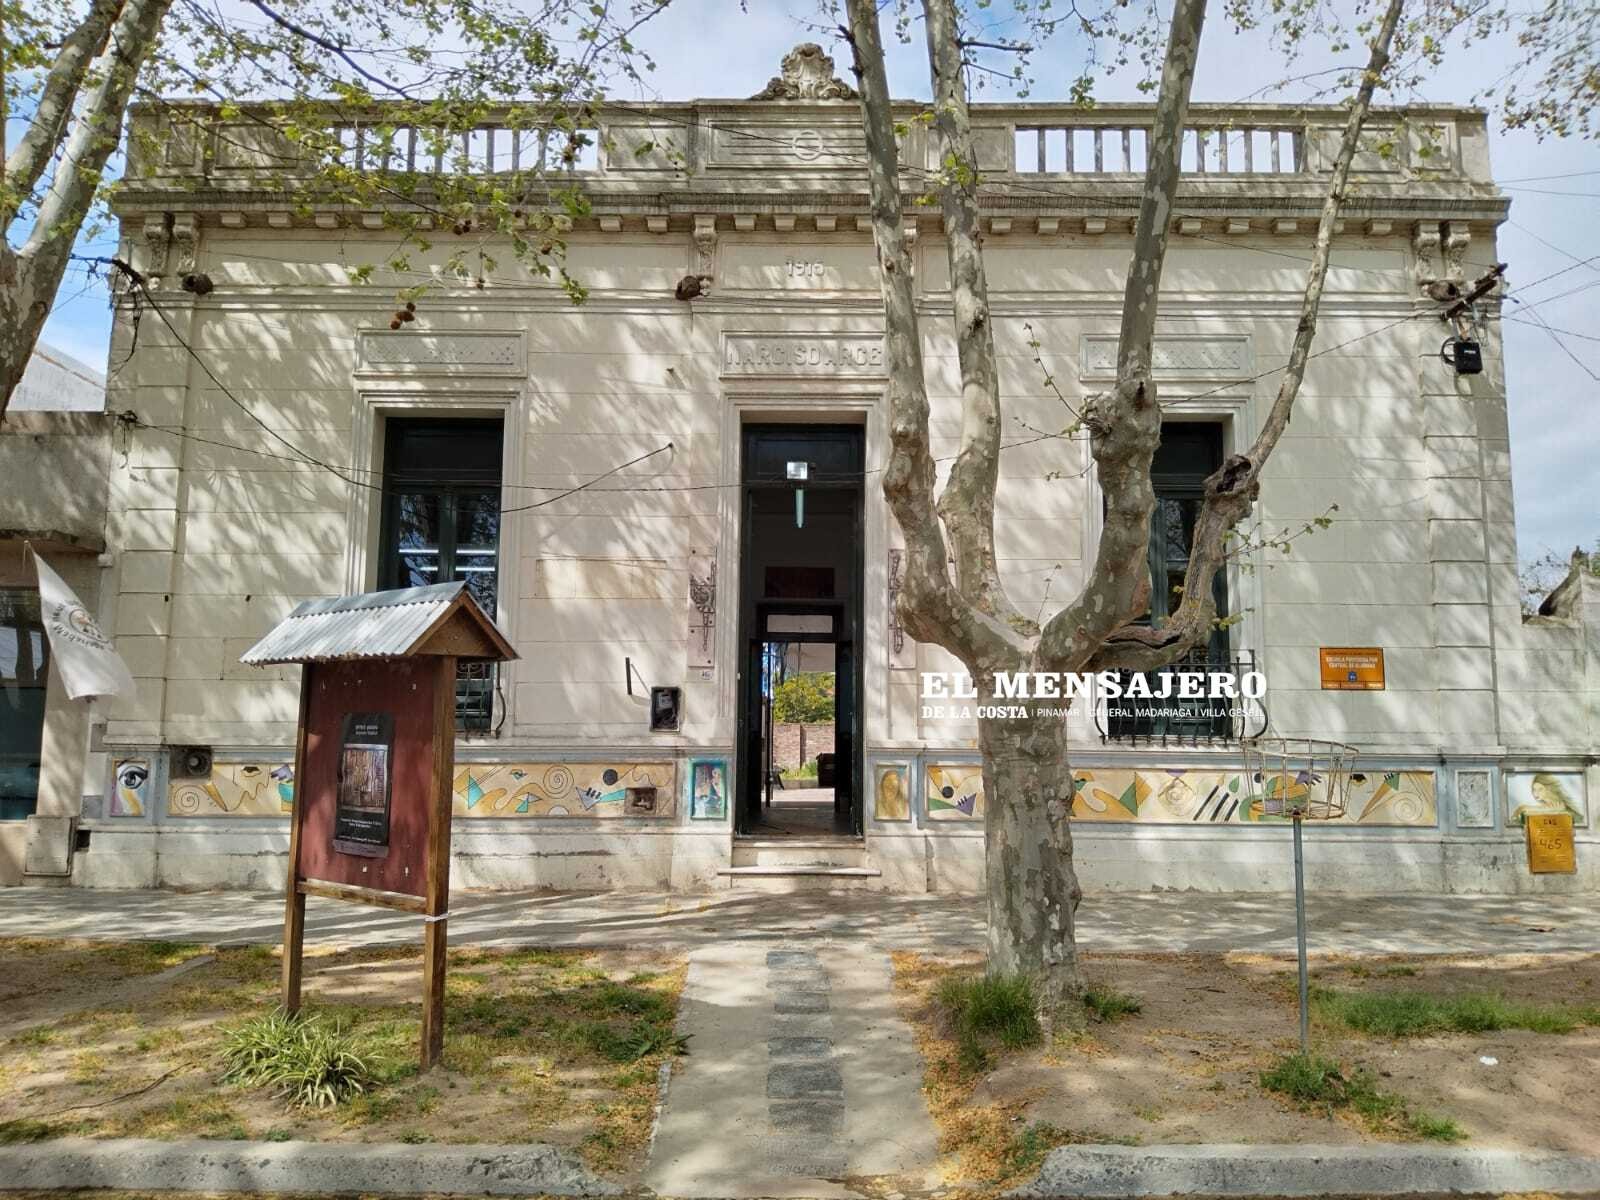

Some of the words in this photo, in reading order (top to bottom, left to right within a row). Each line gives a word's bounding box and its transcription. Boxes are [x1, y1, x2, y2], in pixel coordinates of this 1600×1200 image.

[727, 343, 821, 366] NARCISO
[824, 343, 883, 366] ARCE
[1540, 838, 1562, 850] 465
